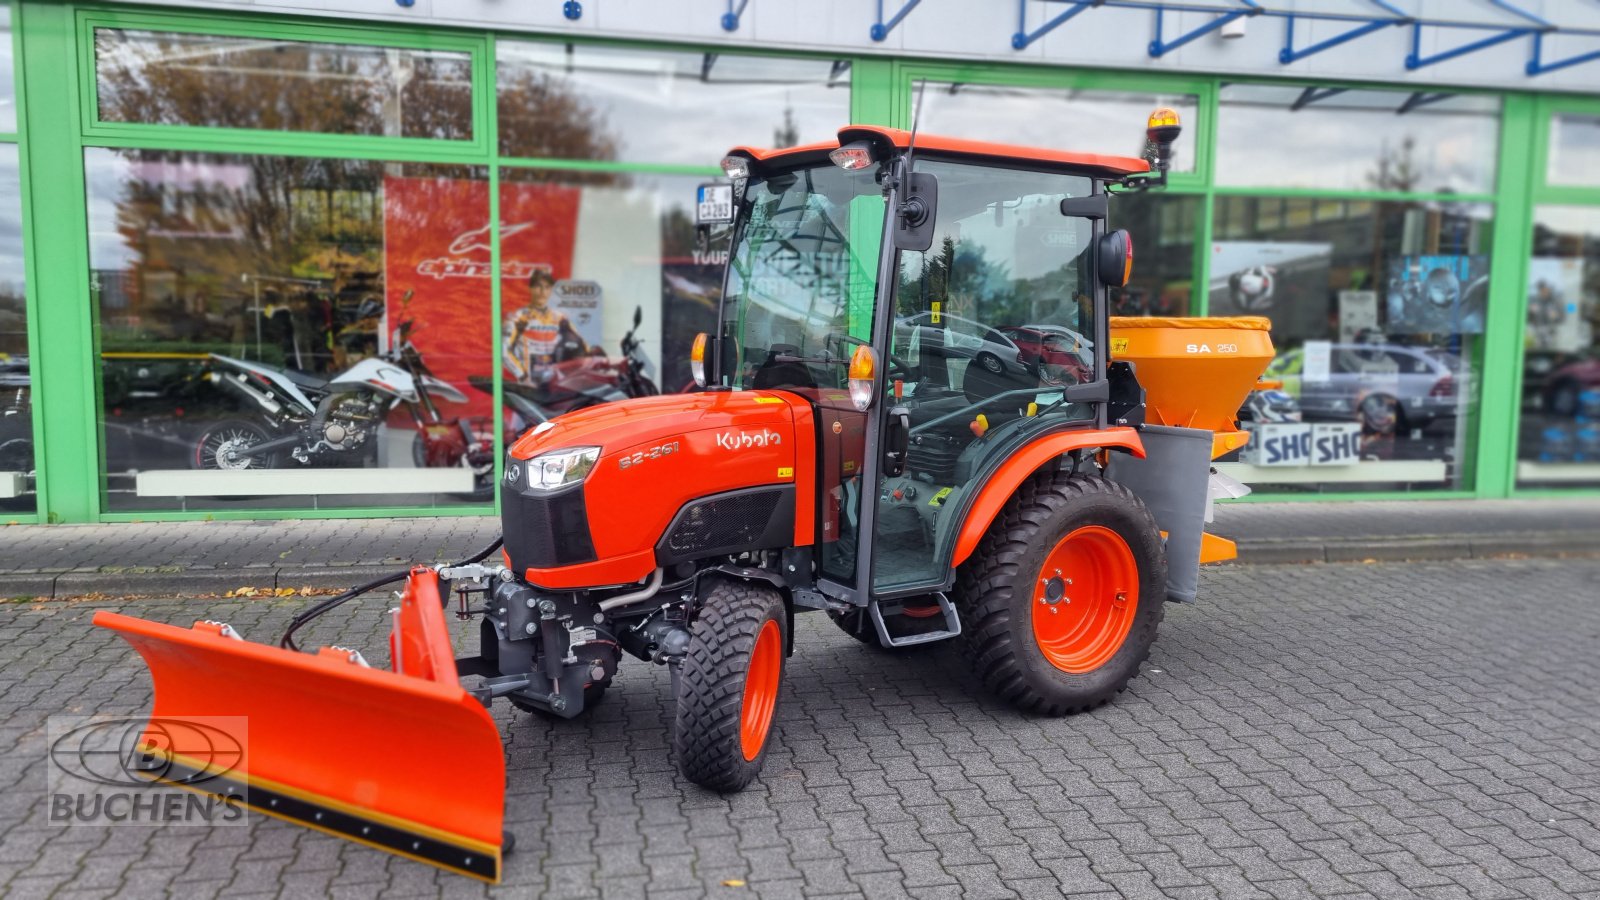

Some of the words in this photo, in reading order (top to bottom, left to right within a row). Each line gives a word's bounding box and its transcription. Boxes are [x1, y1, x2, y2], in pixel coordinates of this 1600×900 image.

[417, 257, 552, 279] alpinetar
[560, 285, 595, 296] SHOEI
[1186, 344, 1212, 353] SA
[1217, 343, 1238, 353] 250
[716, 429, 781, 450] Kubota
